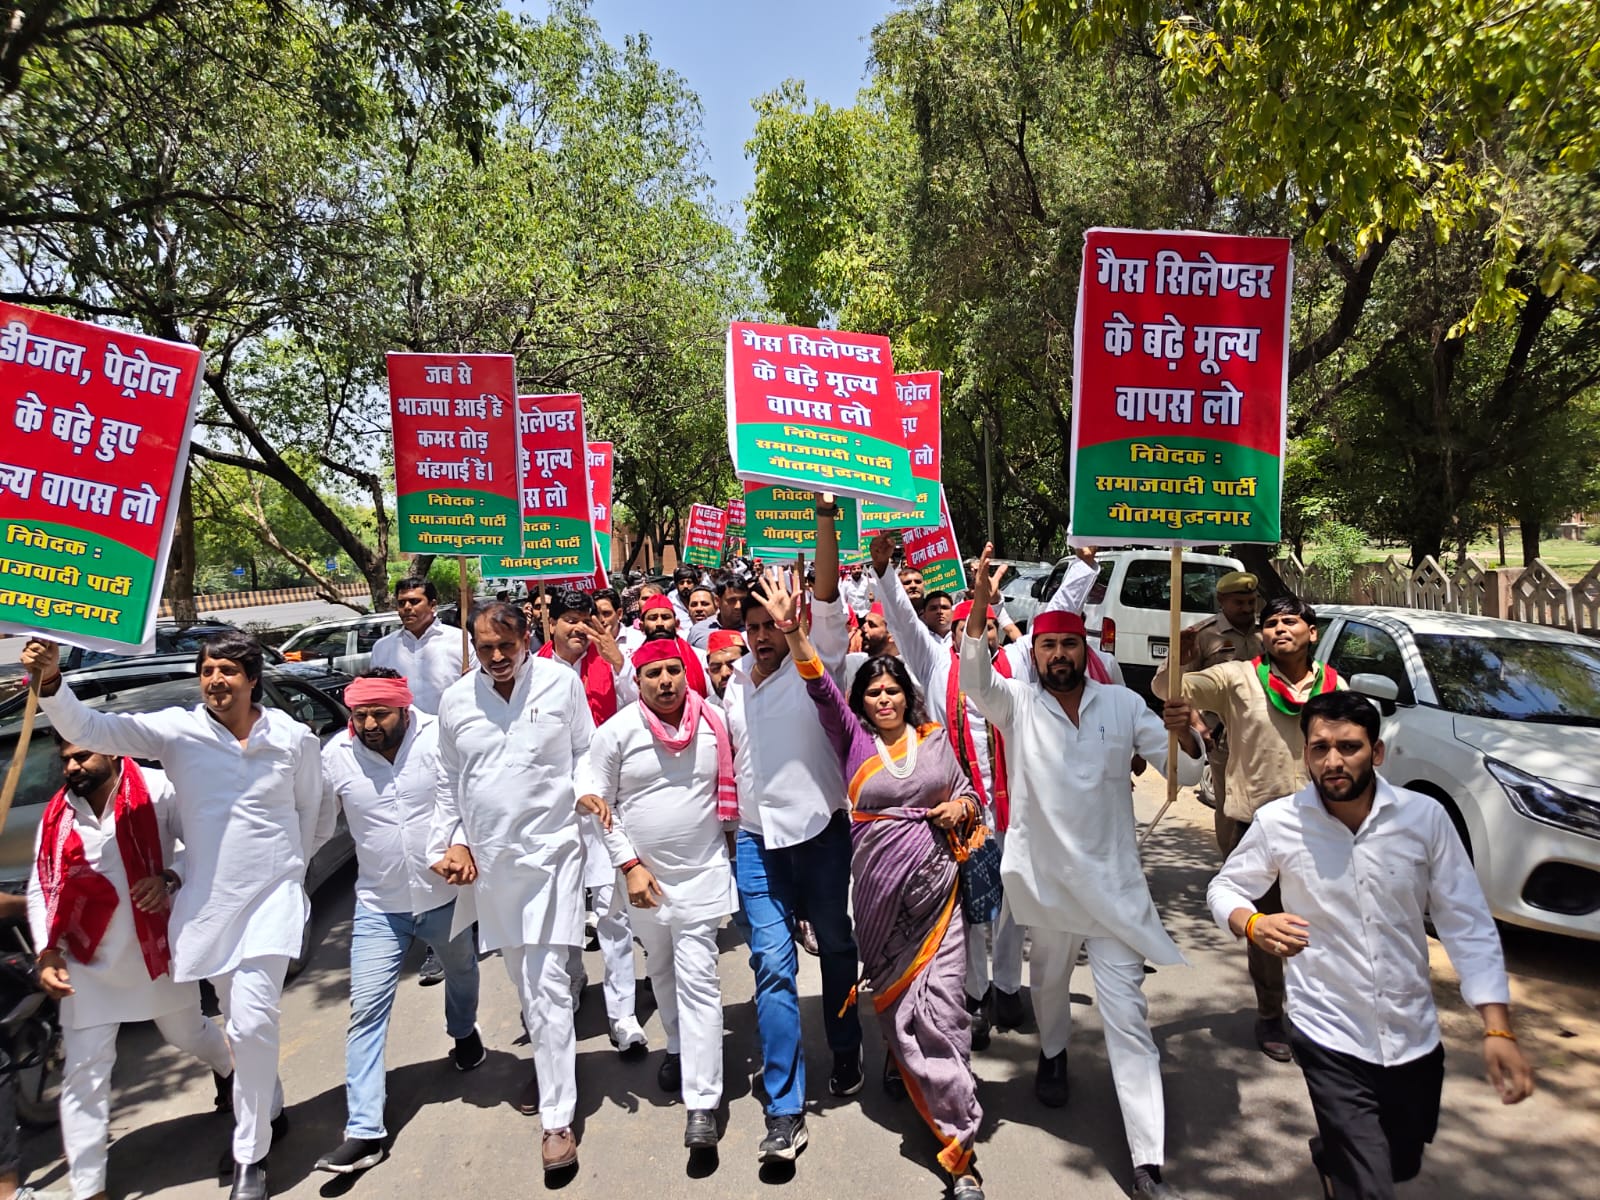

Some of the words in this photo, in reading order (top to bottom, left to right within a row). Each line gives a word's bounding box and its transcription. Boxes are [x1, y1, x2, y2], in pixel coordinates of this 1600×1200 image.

[1096, 248, 1149, 294] गैस
[1155, 250, 1275, 299] सिलेण्डर
[741, 330, 783, 353] गैस
[788, 334, 881, 364] सिलेण्डर
[1103, 311, 1135, 357] के
[1142, 314, 1186, 371] बढ़े
[1193, 326, 1261, 376] मूल्य
[103, 343, 181, 398] पेट्रोल
[424, 366, 453, 385] जब
[457, 362, 473, 385] से
[752, 359, 777, 381] के
[783, 363, 819, 393] बढ़े
[824, 371, 878, 398] मूल्य
[398, 397, 450, 416] भाजपा
[454, 394, 487, 419] आई
[487, 394, 503, 418] है
[766, 395, 832, 421] वापस
[837, 401, 872, 427] लो
[1115, 386, 1195, 425] वापस
[1201, 381, 1243, 426] लो
[15, 392, 46, 433] के
[52, 403, 94, 455] बढ़े
[96, 418, 141, 462] हुए
[783, 425, 848, 444] निवेदक
[416, 430, 455, 448] कमर
[459, 427, 488, 455] तोड़
[755, 439, 850, 461] समाजवादी
[855, 454, 893, 470] पार्टी
[914, 443, 934, 465] लो
[1130, 443, 1206, 464] निवेदक
[416, 457, 470, 482] मंहगाई
[534, 448, 573, 478] मूल्य
[0, 463, 37, 499] ल्य
[41, 472, 117, 516] वापस
[120, 483, 160, 524] लो
[544, 480, 568, 508] लो
[1096, 474, 1205, 496] समाजवादी
[1212, 476, 1257, 497] पार्टी
[428, 493, 475, 507] निवेदक
[408, 514, 475, 526] समाजवादी
[480, 514, 507, 527] पार्टी
[523, 521, 551, 533] वेदक
[696, 508, 723, 520] NEET
[755, 508, 815, 521] समाजवादी
[1108, 502, 1251, 529] गौतमबुद्धनगर
[6, 524, 88, 556] निवेदक
[556, 536, 581, 549] पार्टी
[87, 573, 133, 596] पार्टी
[0, 588, 121, 624] तमबुद्धनगर
